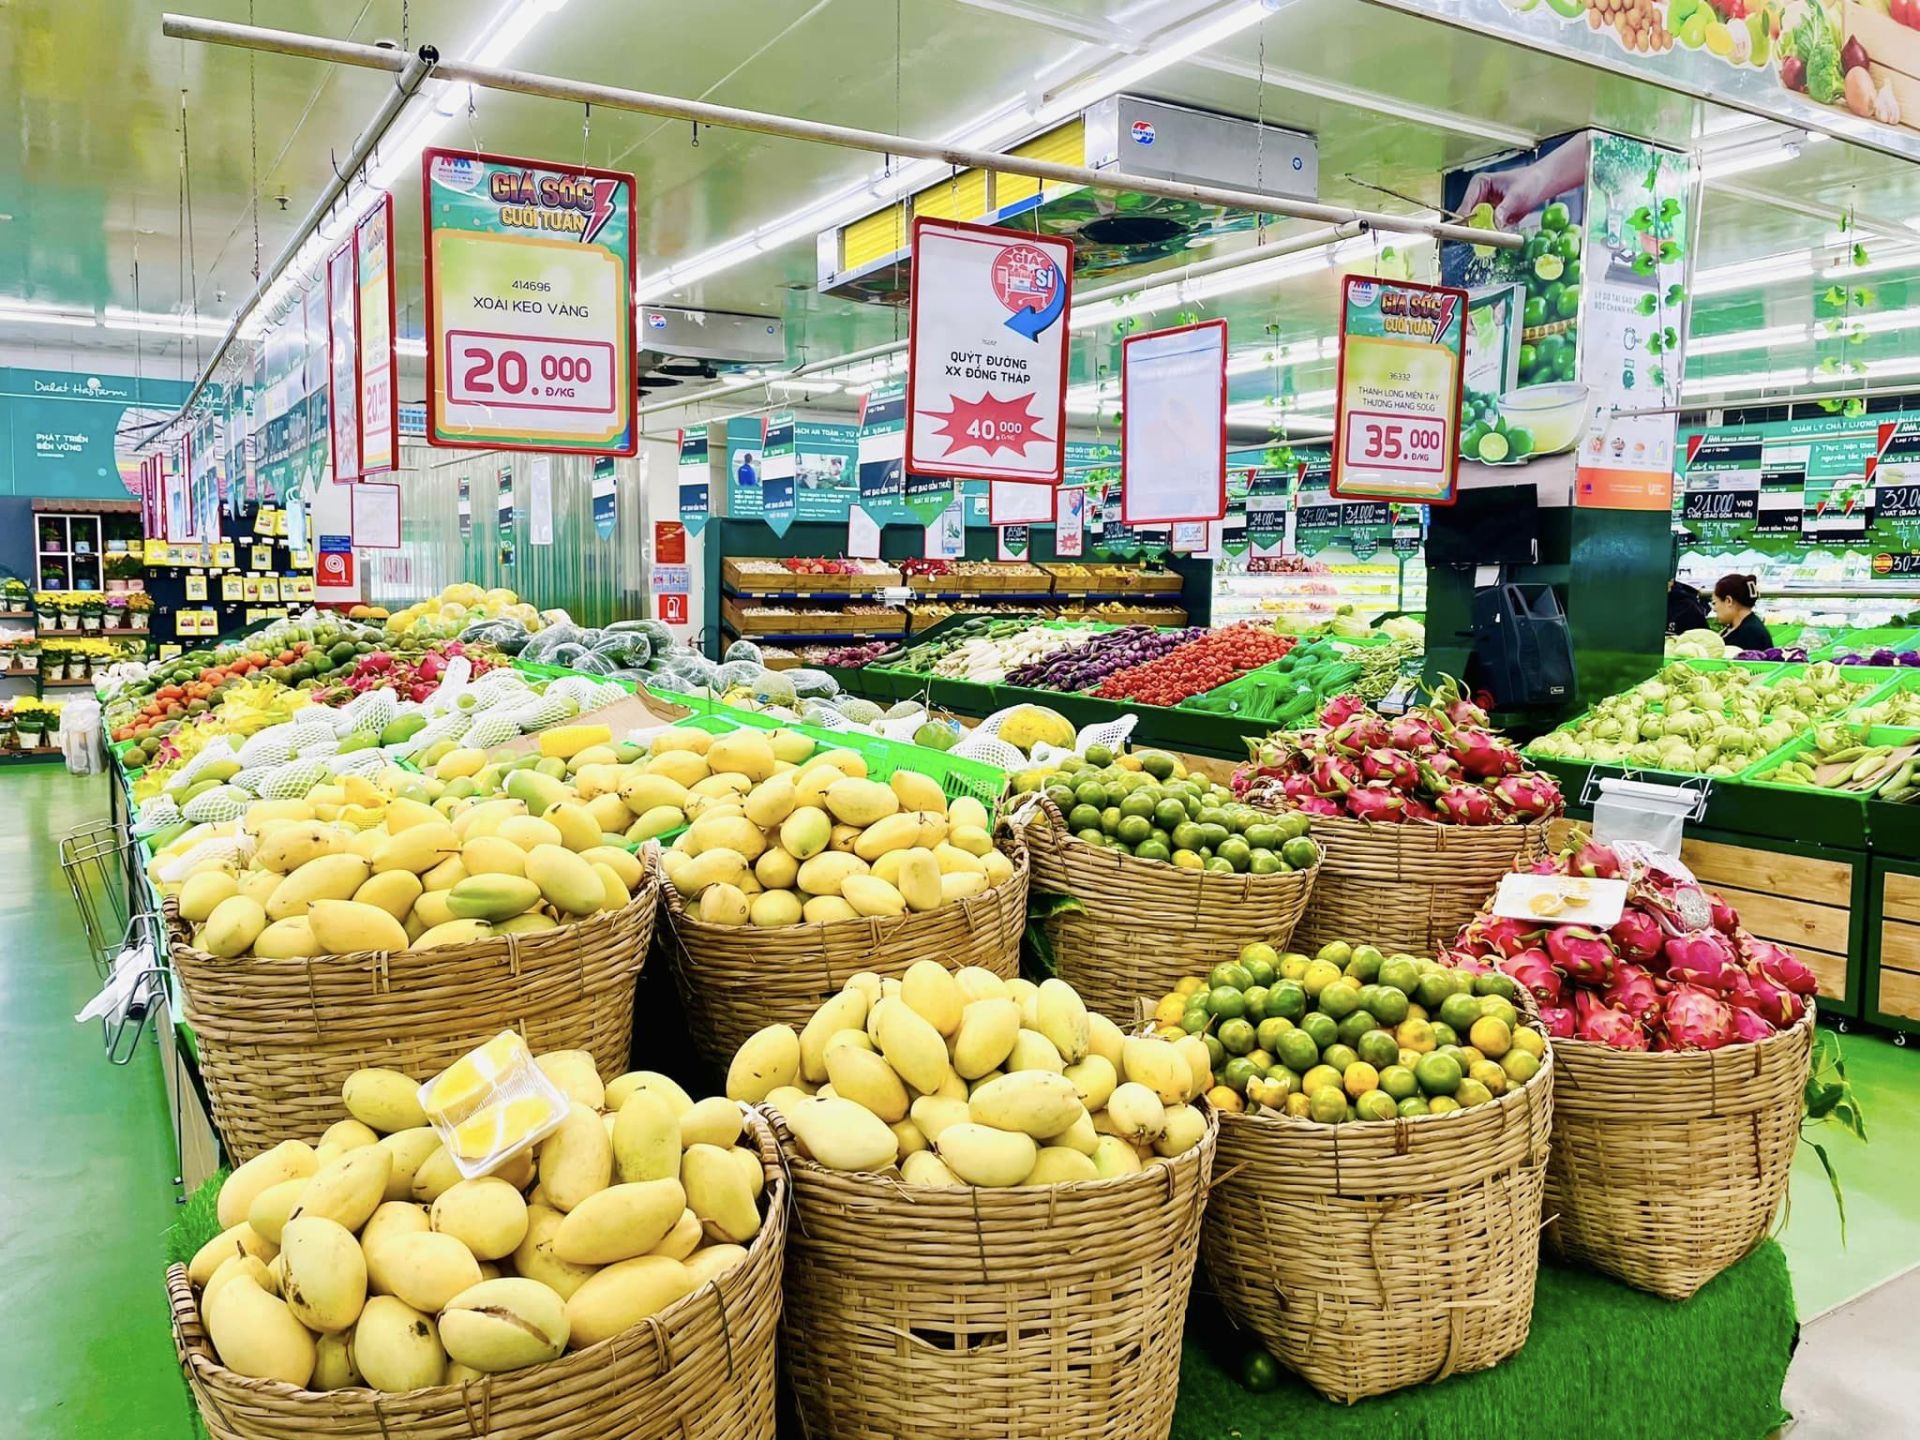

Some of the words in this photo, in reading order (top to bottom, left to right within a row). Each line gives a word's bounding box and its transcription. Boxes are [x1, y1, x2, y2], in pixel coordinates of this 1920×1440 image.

[491, 170, 537, 204] GIÁ
[540, 175, 594, 212] SỐC
[501, 207, 540, 227] CUỐI
[512, 280, 551, 292] 414696
[474, 296, 508, 311] XOÀI
[548, 302, 589, 318] VÀNG
[950, 350, 982, 366] QUÝT
[986, 354, 1027, 370] ĐƯỜNG
[945, 366, 961, 376] XX
[1001, 372, 1031, 384] THÁP
